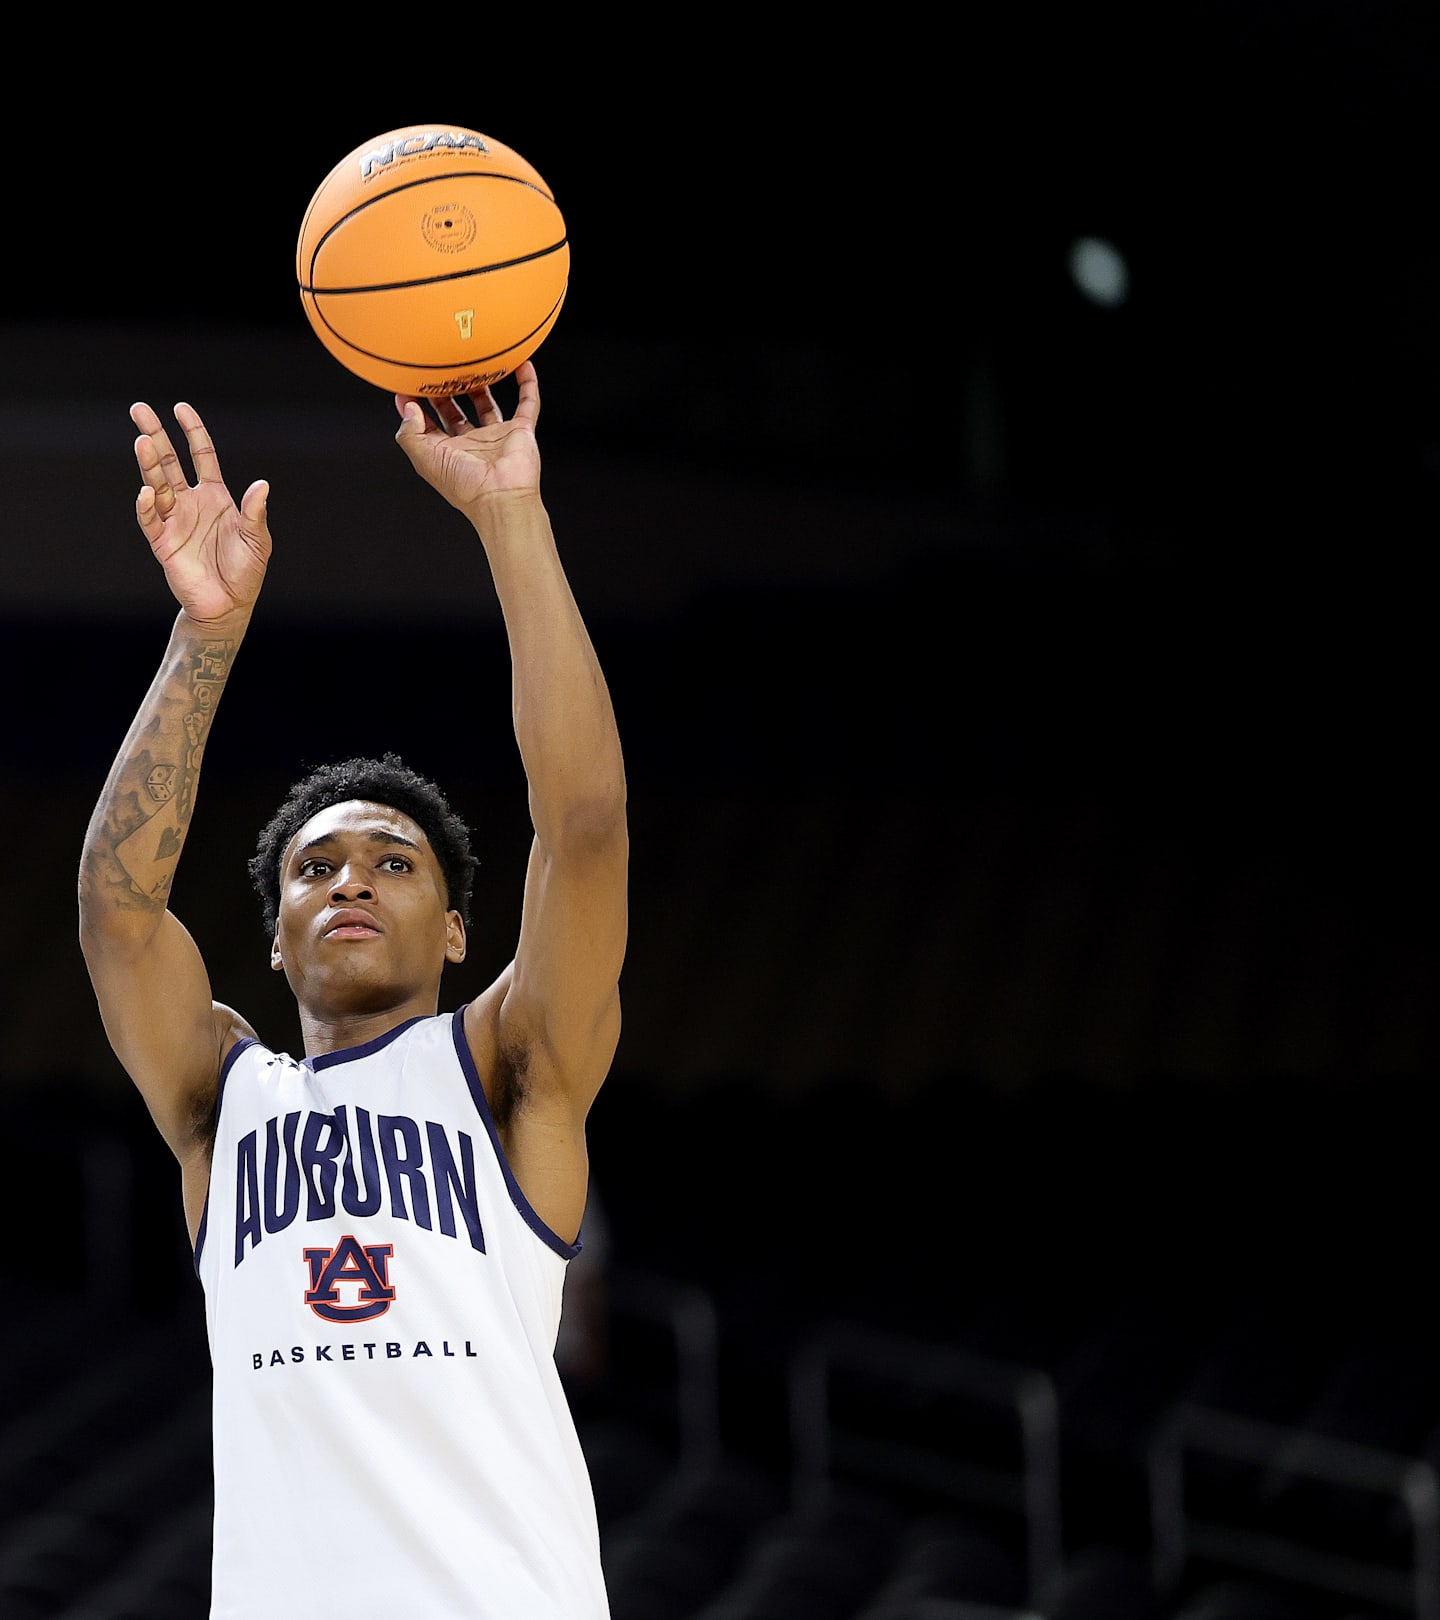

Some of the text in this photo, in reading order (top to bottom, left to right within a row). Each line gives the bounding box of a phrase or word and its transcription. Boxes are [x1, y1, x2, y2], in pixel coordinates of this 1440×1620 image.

[360, 132, 489, 178] NCAA
[234, 1105, 486, 1270] AUBURN
[253, 1341, 477, 1370] BASKETBALL
